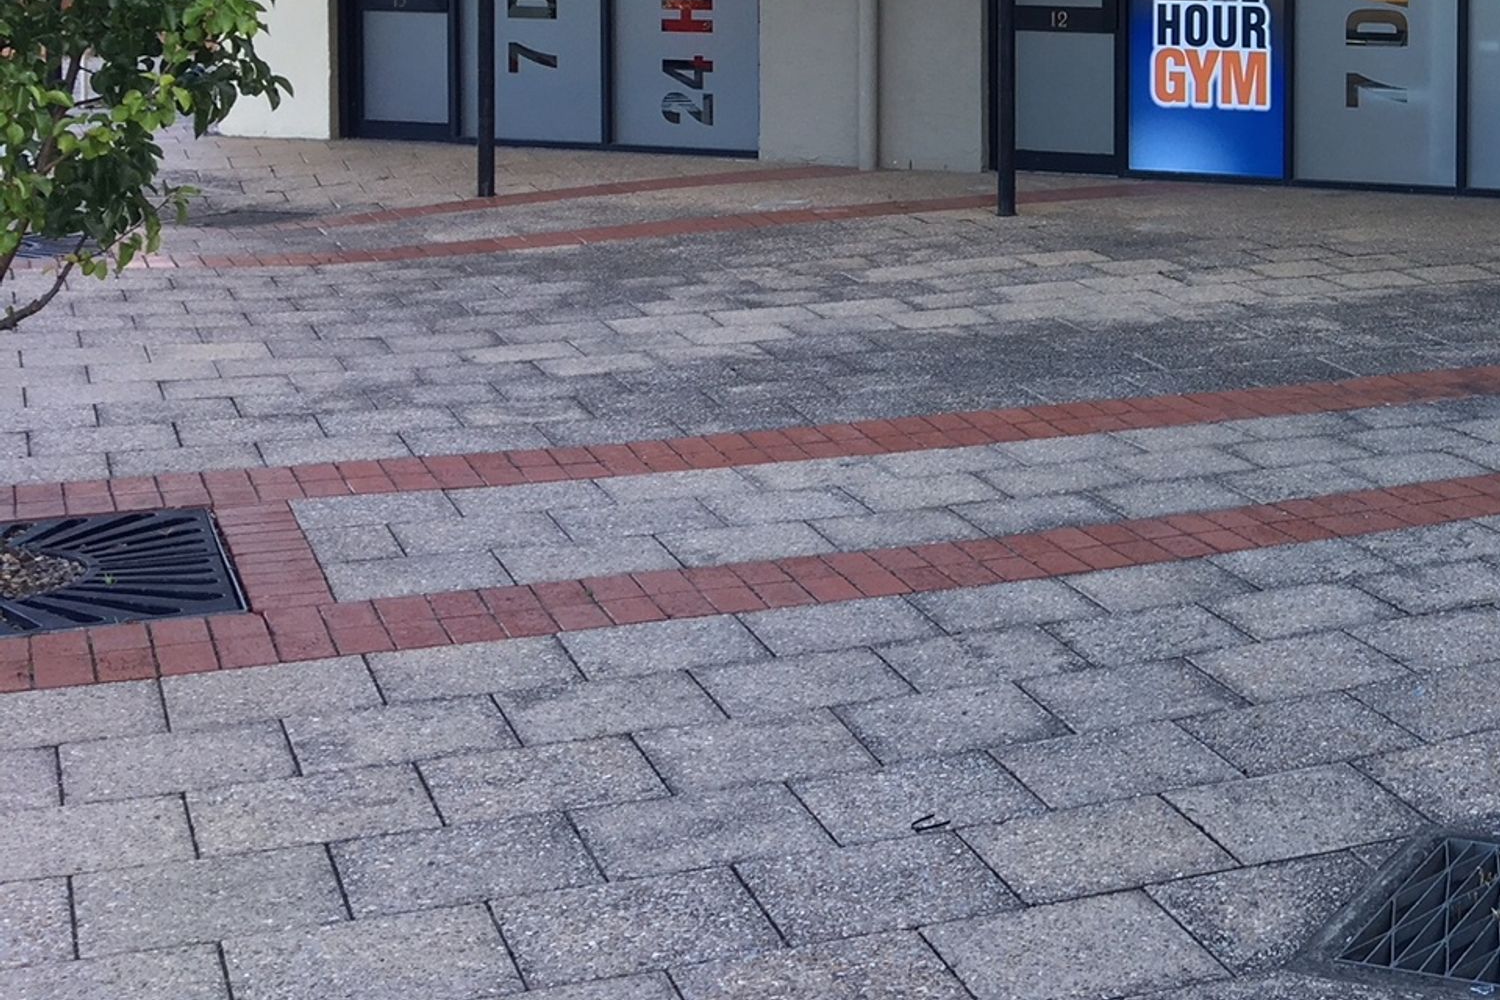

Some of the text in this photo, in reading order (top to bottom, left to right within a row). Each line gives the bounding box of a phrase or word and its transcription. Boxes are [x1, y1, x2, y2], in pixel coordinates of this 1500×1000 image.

[1050, 10, 1068, 29] 12
[1155, 2, 1270, 49] HOUR
[508, 42, 558, 74] 7
[1152, 48, 1270, 109] GYM
[661, 56, 714, 127] 24
[1346, 73, 1408, 109] 7
